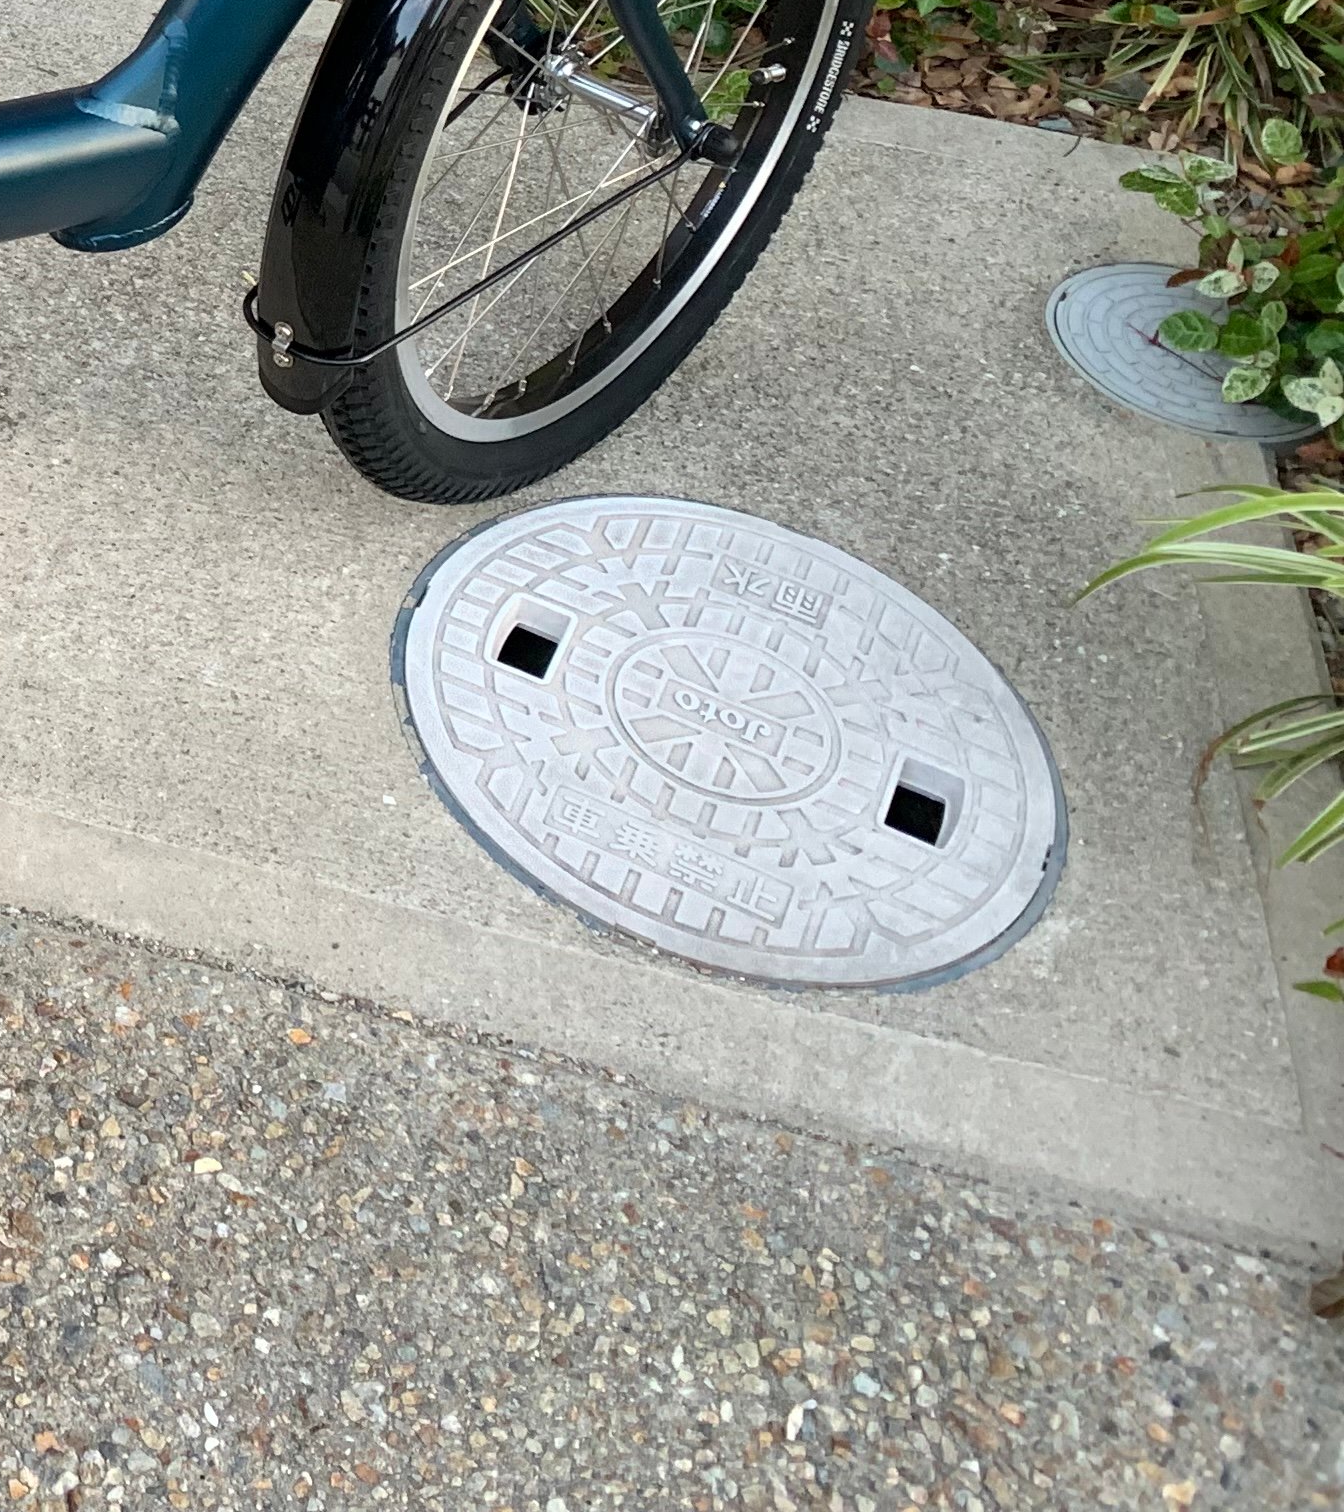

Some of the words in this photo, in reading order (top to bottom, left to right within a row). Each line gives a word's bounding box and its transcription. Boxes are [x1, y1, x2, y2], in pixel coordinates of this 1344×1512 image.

[813, 39, 851, 115] BRIDGESTONE
[723, 563, 825, 624] 雨水
[673, 689, 772, 744] Joto
